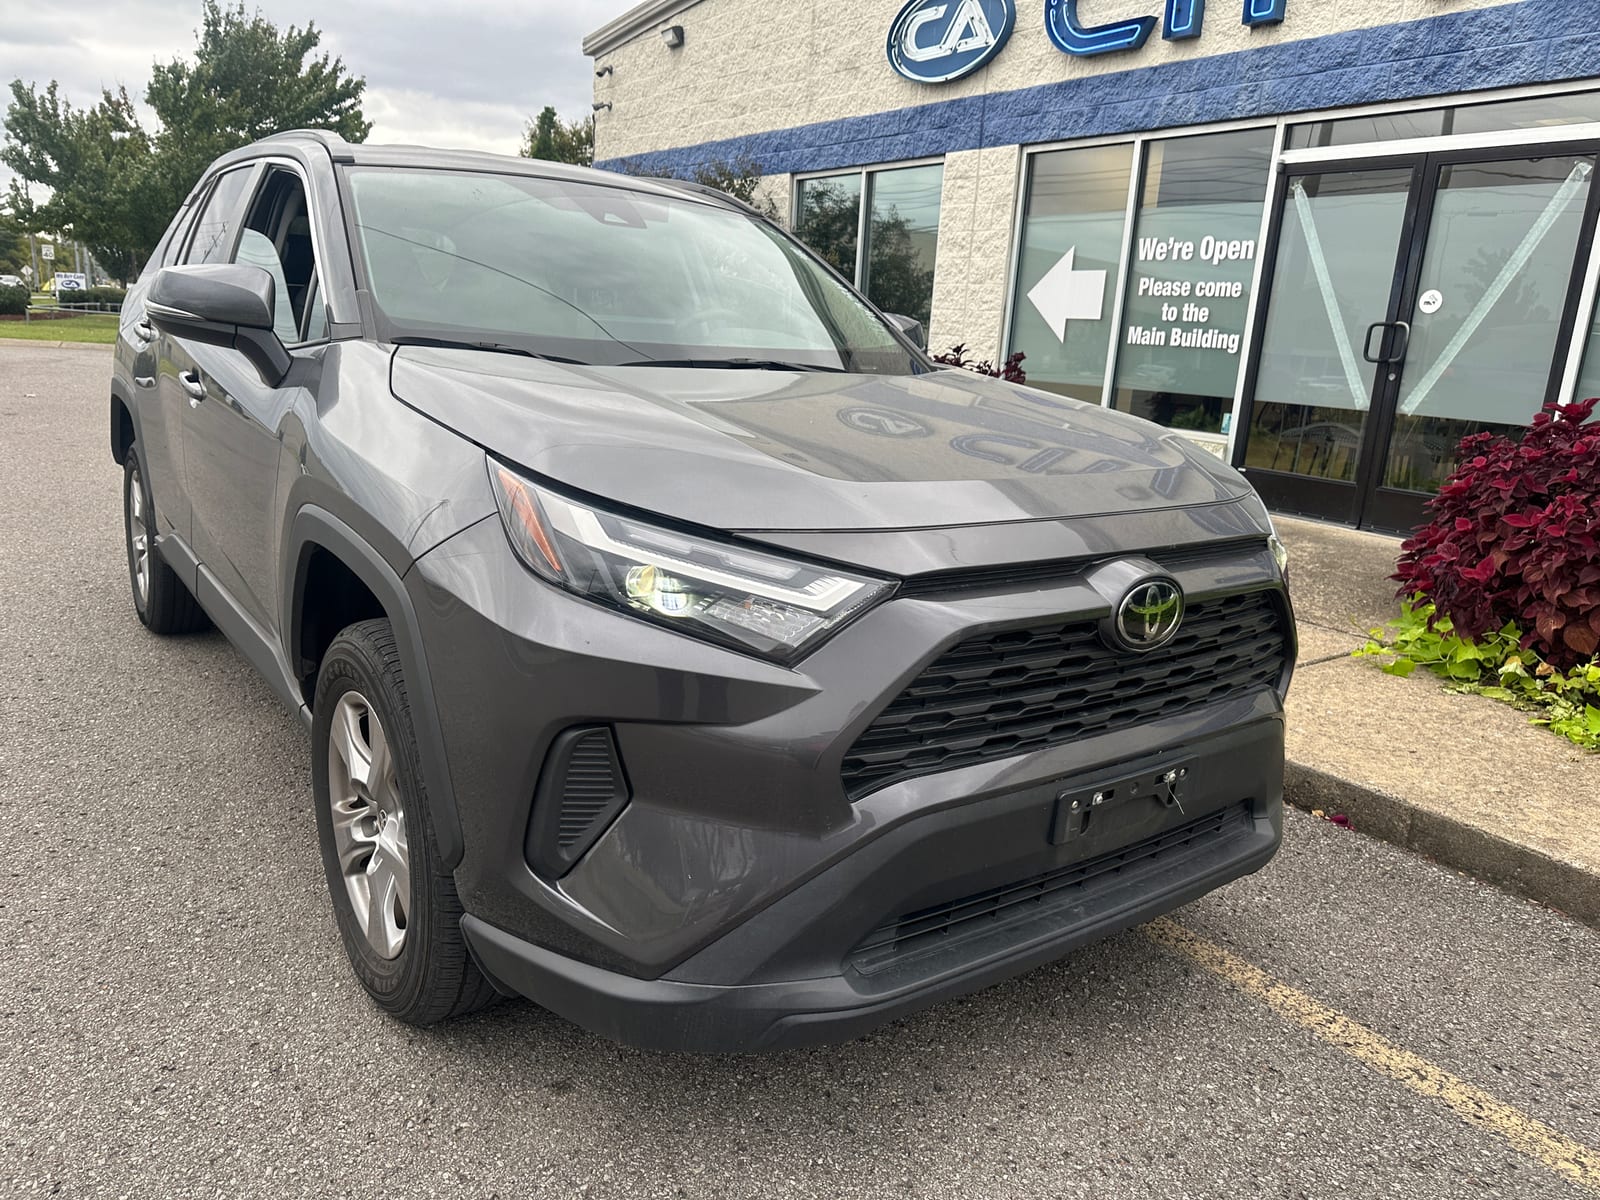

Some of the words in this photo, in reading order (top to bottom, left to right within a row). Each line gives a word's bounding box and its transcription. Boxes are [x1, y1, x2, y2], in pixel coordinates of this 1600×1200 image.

[902, 0, 994, 62] CA
[1138, 237, 1194, 261] We're
[1200, 235, 1255, 265] Open
[1138, 277, 1190, 296] Please
[1195, 281, 1242, 297] come
[1162, 302, 1178, 321] to
[1182, 303, 1209, 322] the
[1127, 326, 1166, 346] Main
[1170, 327, 1240, 354] Building
